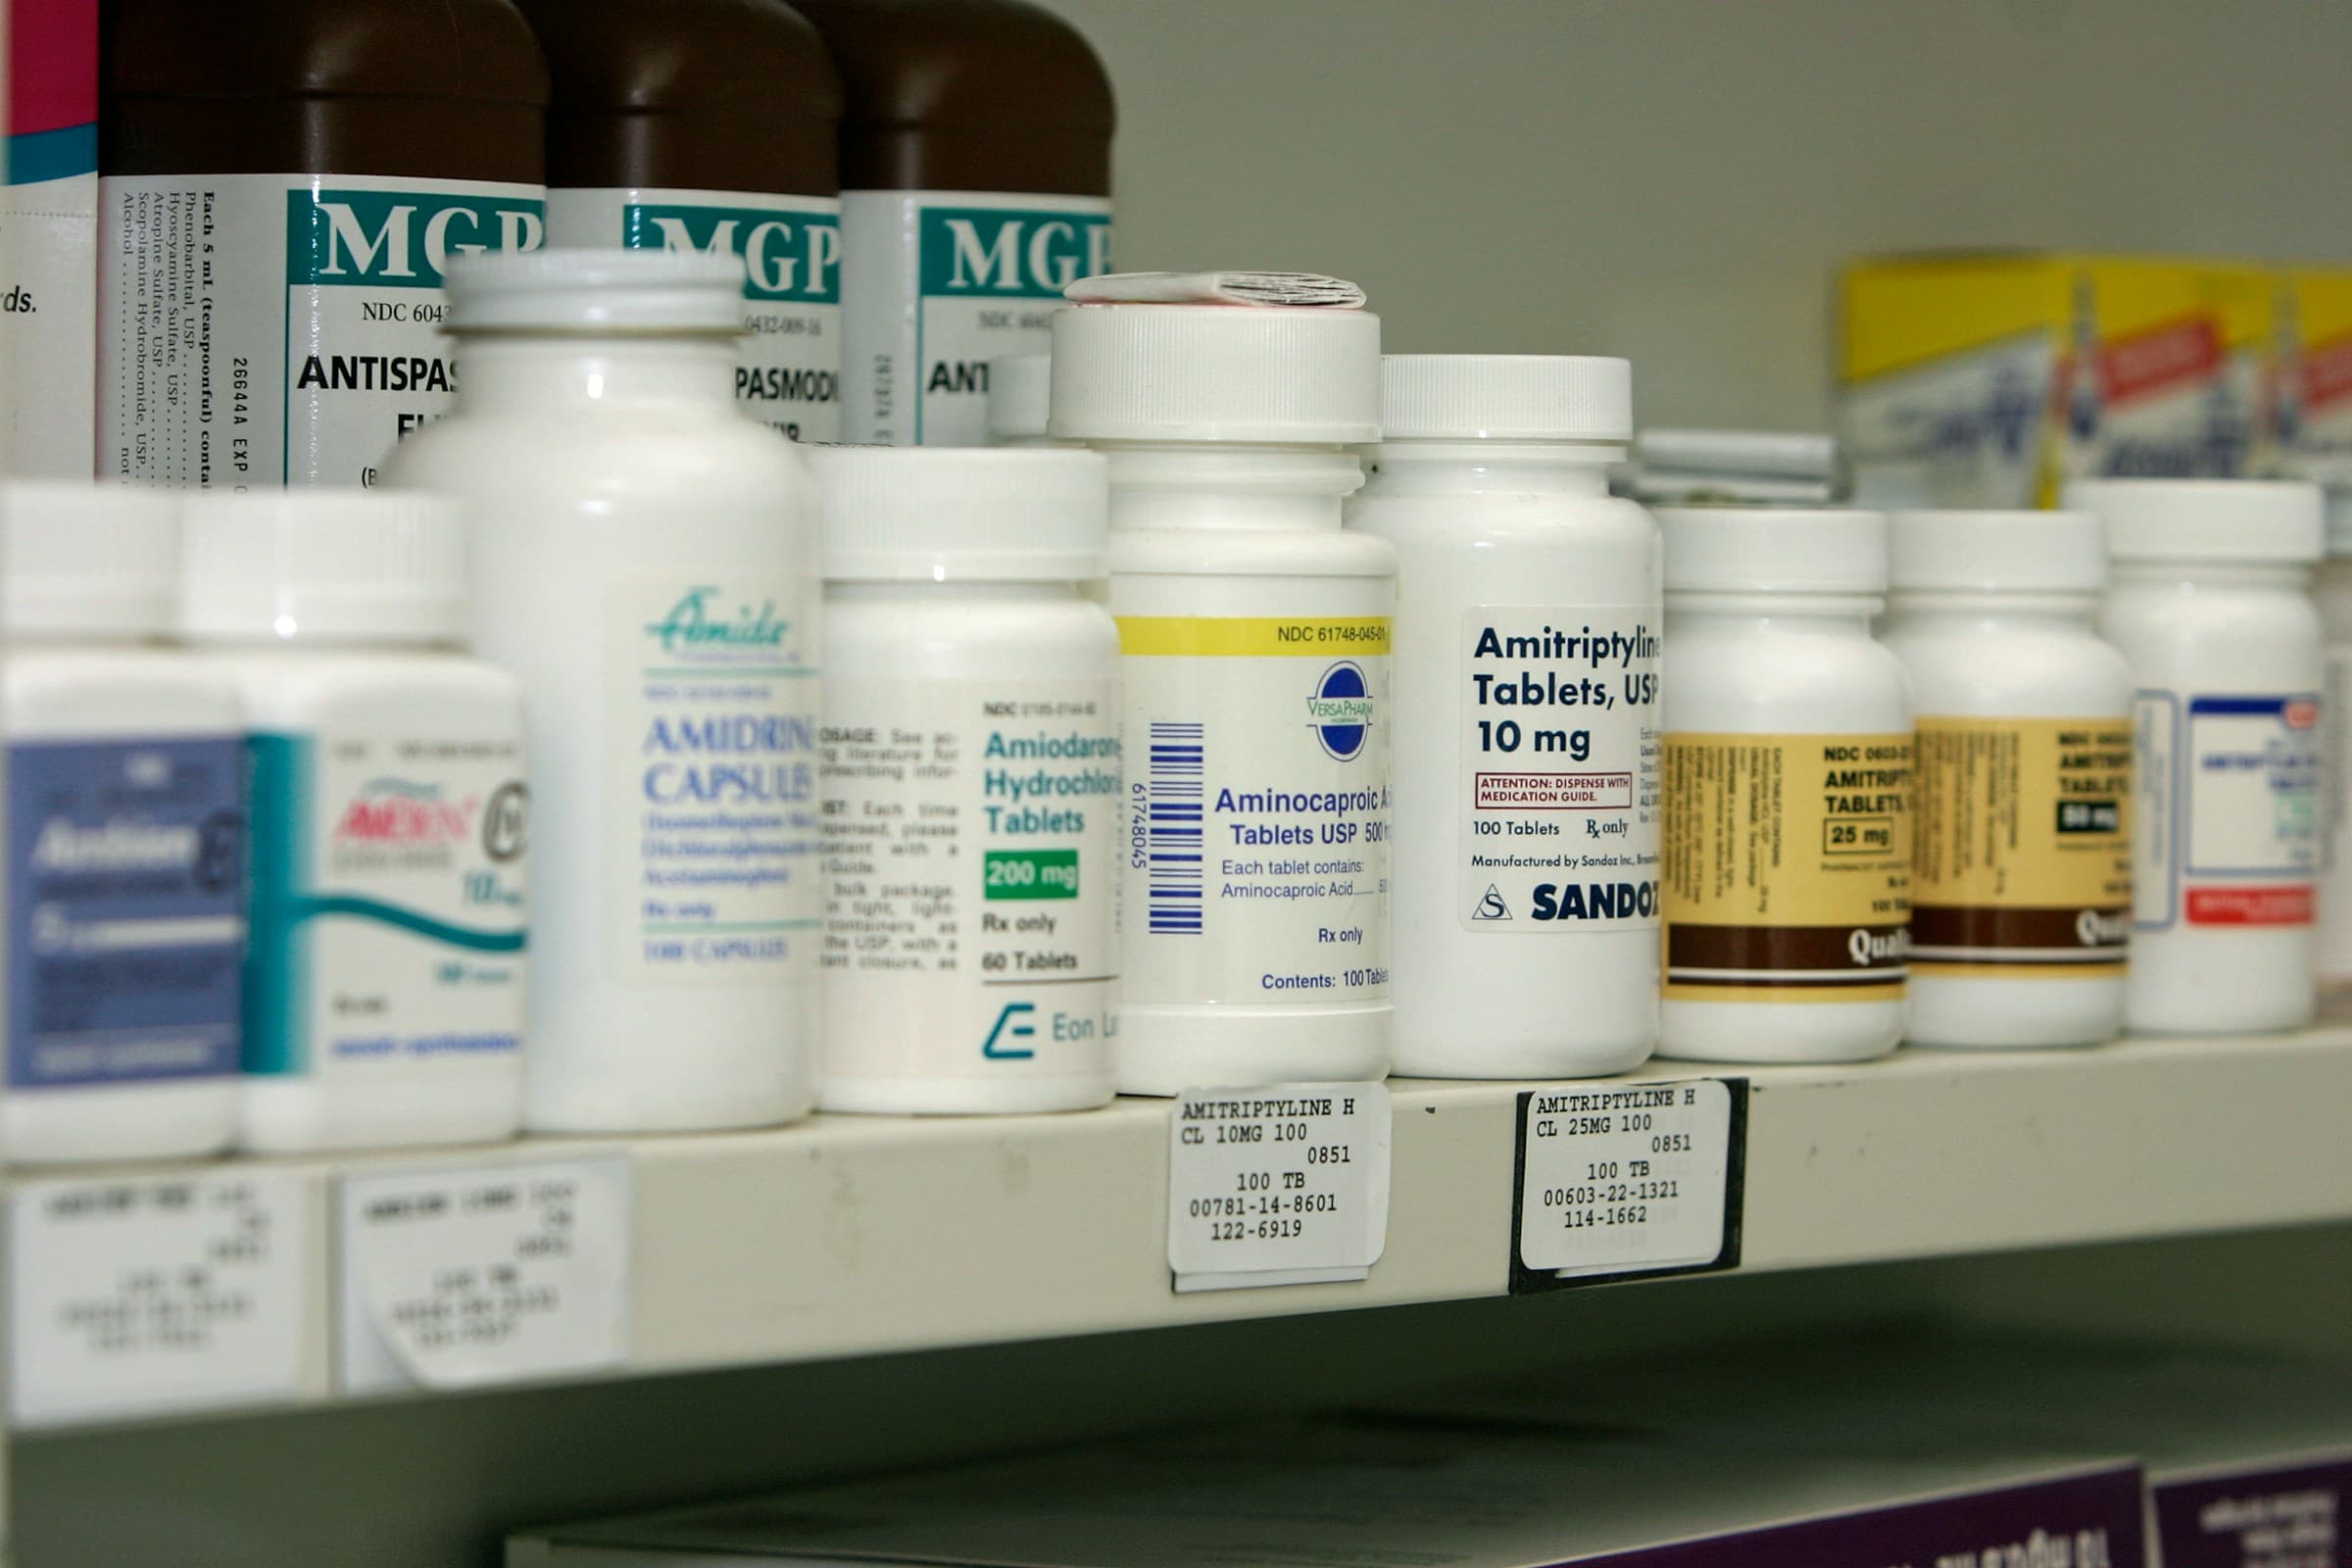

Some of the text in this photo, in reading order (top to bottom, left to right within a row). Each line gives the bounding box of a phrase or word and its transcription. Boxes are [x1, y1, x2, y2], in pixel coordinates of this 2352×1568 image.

[202, 191, 215, 235] Each
[135, 192, 150, 297] Scopolamine
[202, 243, 215, 253] 5
[315, 203, 543, 276] MGP
[150, 192, 165, 367] Atropine Sulfate, USP
[181, 191, 195, 350] Phenobarbital, USP
[202, 261, 215, 290] mL
[166, 192, 180, 406] Hyoscyamine Sulfate, USP
[363, 302, 407, 322] NDC
[120, 192, 135, 474] Alcohol not
[134, 303, 149, 425] Hydrobromide,
[199, 297, 215, 423] (teaspoonful)
[232, 358, 249, 472] 26644A EXP
[1277, 625, 1386, 643] NDC 61748-045-01
[1473, 671, 1659, 710] Tablets, USP
[1478, 719, 1591, 761] 10 mg
[1824, 746, 1860, 761] NDC
[1481, 777, 1630, 789] ATTENTION: DISPENSE WITH
[1214, 786, 1379, 817] Aminocaproic
[1480, 791, 1596, 802] MEDICATION GUIDE.
[984, 807, 1086, 833] Tablets
[1131, 782, 1148, 869] 61748045
[1473, 820, 1560, 835] 100 Tablets
[1602, 817, 1630, 838] only
[1229, 821, 1384, 845] Tablets USP 500
[1831, 826, 1889, 848] 25 mg
[1222, 858, 1365, 875] Each tablet contains:
[1471, 855, 1561, 867] Manufactured
[1564, 856, 1579, 870] by
[1581, 855, 1618, 867] Sandoz
[987, 860, 1077, 890] 200 mg
[1221, 882, 1326, 901] Aminocaproic
[982, 913, 1056, 935] Rx only
[1318, 926, 1363, 945] Rx only
[982, 952, 1078, 971] 60 Tablets
[1261, 973, 1337, 990] Contents:
[1344, 969, 1364, 987] 100
[1052, 1012, 1094, 1042] Eon
[1181, 1098, 1356, 1120] AMITRIPTYLINE H
[1536, 1089, 1696, 1114] AMITRIPTYLINE H
[1181, 1123, 1308, 1145] CL 10MG 100
[1537, 1113, 1652, 1137] CL 25MG 100
[1307, 1146, 1351, 1164] 0851
[1651, 1134, 1691, 1153] 0851
[1237, 1172, 1305, 1191] 100 TB
[1587, 1160, 1650, 1181] 100 TB
[1544, 1180, 1679, 1206] 00603-22-1321
[1190, 1194, 1338, 1217] 00781-14-8601
[1564, 1206, 1647, 1229] 114-1662
[1211, 1219, 1302, 1241] 122-6919
